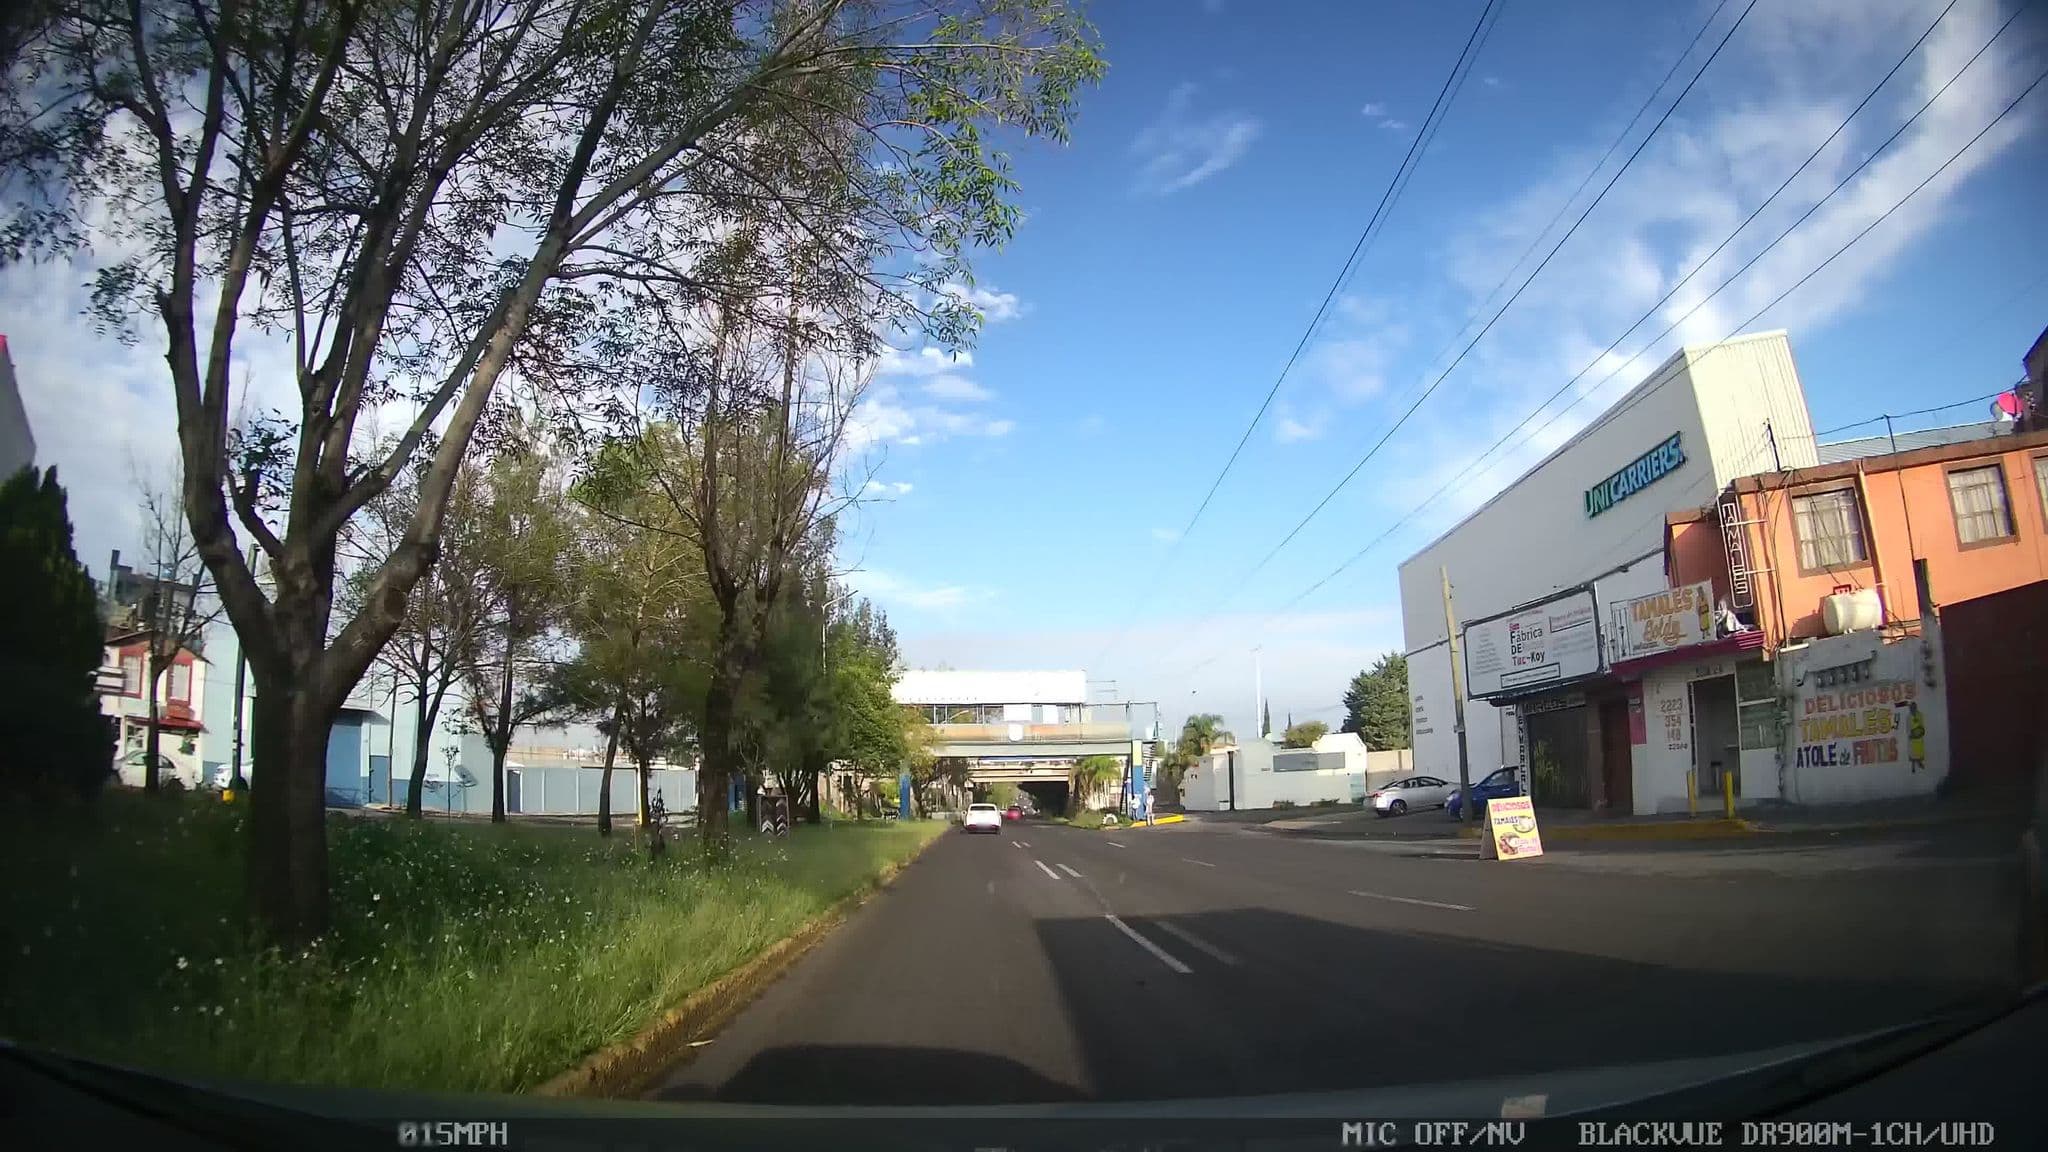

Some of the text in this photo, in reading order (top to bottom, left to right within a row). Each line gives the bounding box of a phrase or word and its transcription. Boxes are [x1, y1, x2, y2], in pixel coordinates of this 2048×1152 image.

[1584, 434, 1682, 517] UNICARRIERS
[1722, 503, 1748, 594] TAMALES
[1630, 588, 1693, 622] TAMALES
[1510, 627, 1543, 645] Fábrica
[1511, 643, 1522, 655] DE
[1804, 681, 1917, 714] DELICIOSOS
[1798, 707, 1892, 742] TAMALES
